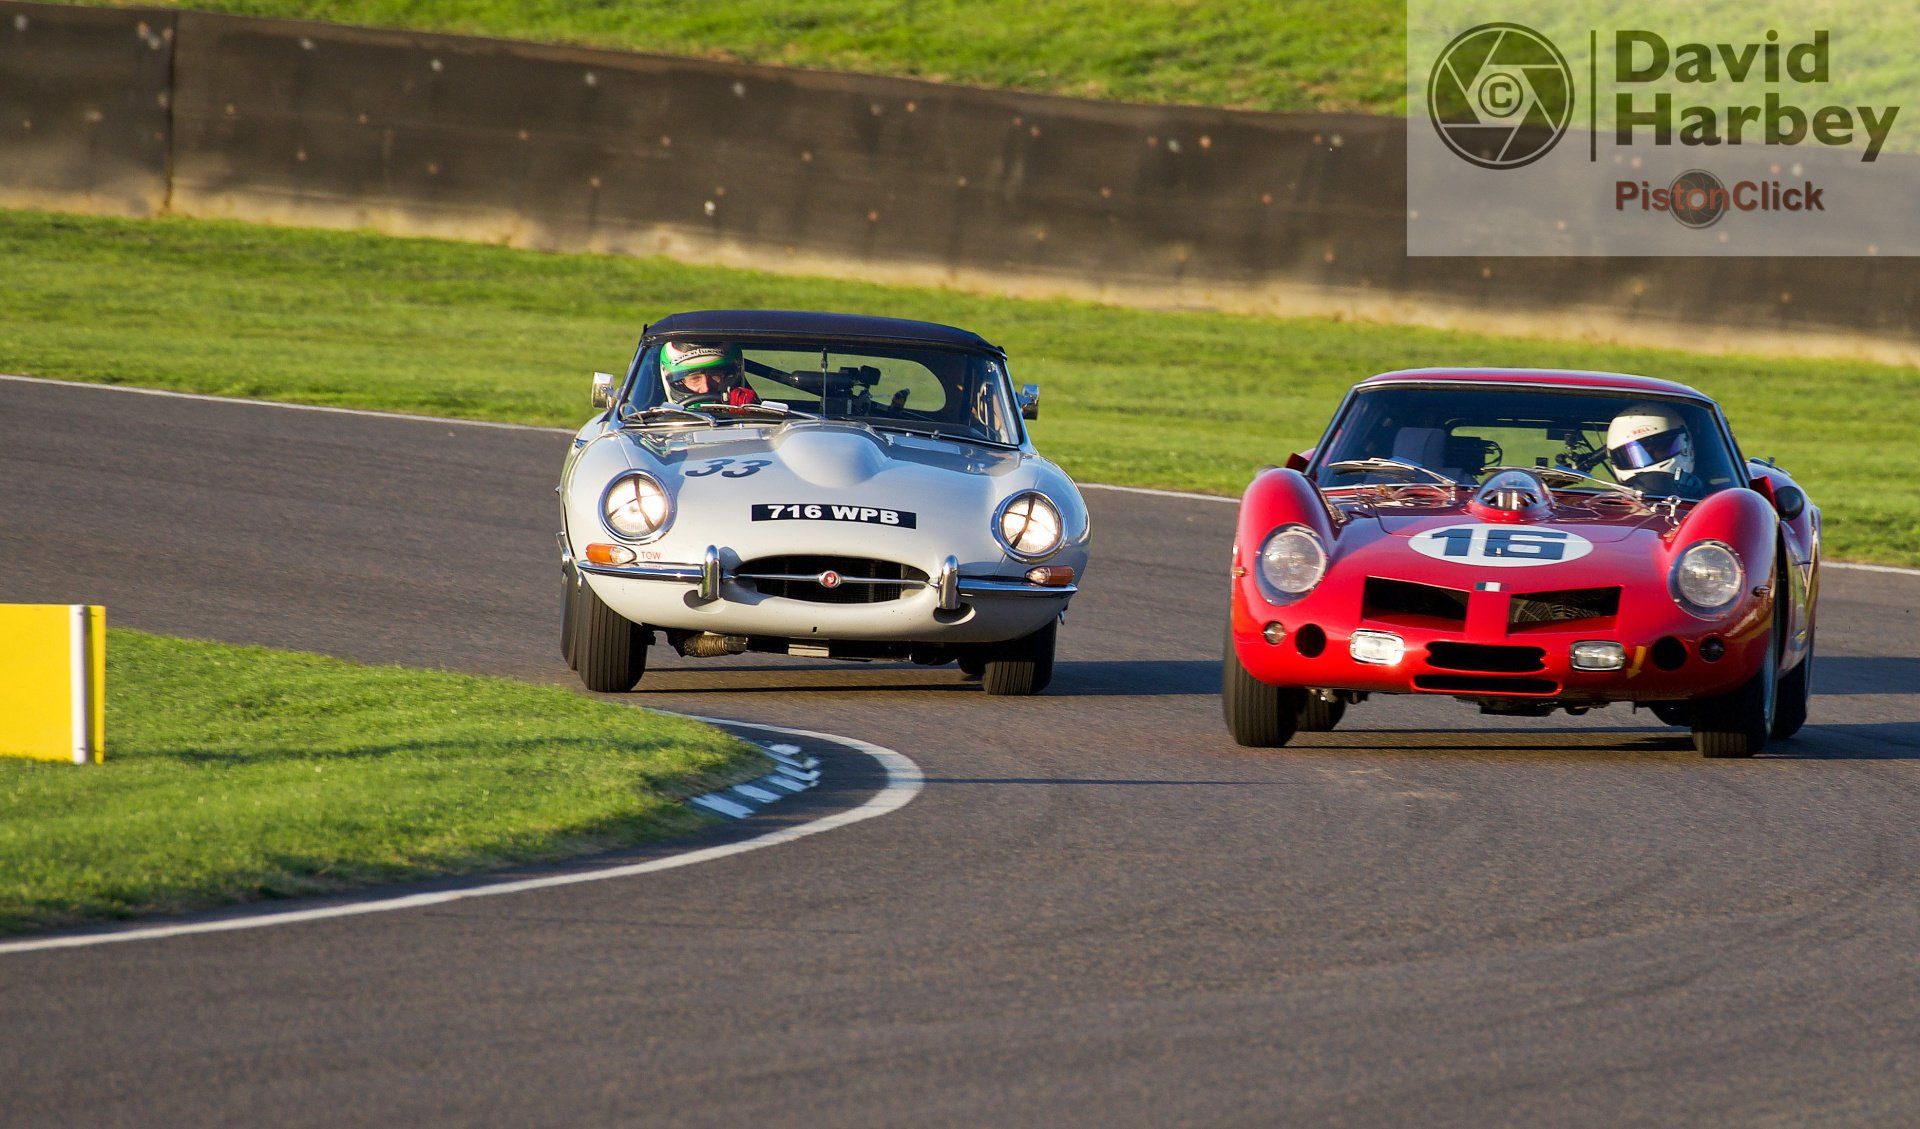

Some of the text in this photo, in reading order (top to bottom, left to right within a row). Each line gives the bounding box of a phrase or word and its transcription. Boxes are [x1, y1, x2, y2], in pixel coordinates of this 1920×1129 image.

[686, 459, 773, 478] 33
[767, 504, 901, 525] 716 WPB
[1431, 528, 1568, 561] 16
[641, 551, 662, 560] TOW
